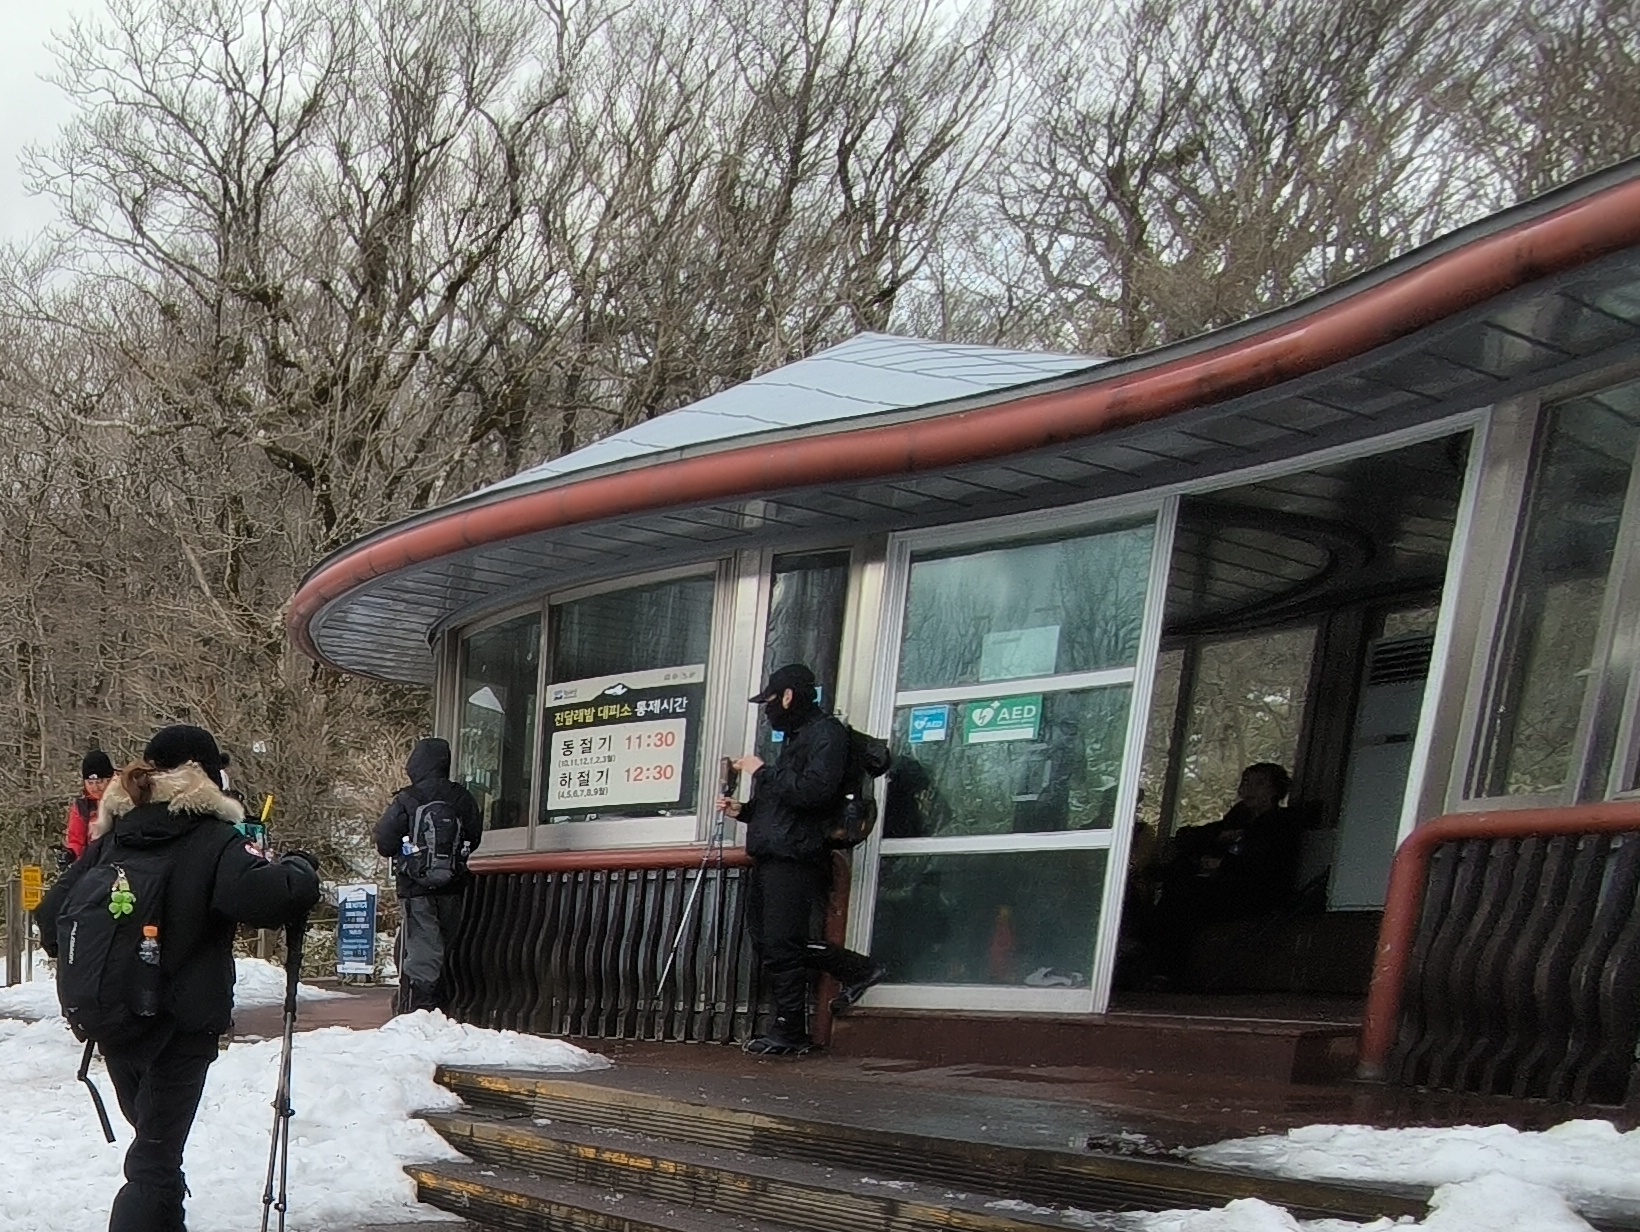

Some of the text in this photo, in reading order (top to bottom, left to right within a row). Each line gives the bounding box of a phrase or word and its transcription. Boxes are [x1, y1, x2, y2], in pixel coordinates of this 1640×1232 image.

[597, 703, 632, 720] 대피소
[634, 697, 688, 717] 통제시간
[997, 705, 1036, 721] AED
[625, 731, 676, 750] 11:30
[625, 764, 674, 782] 12:30
